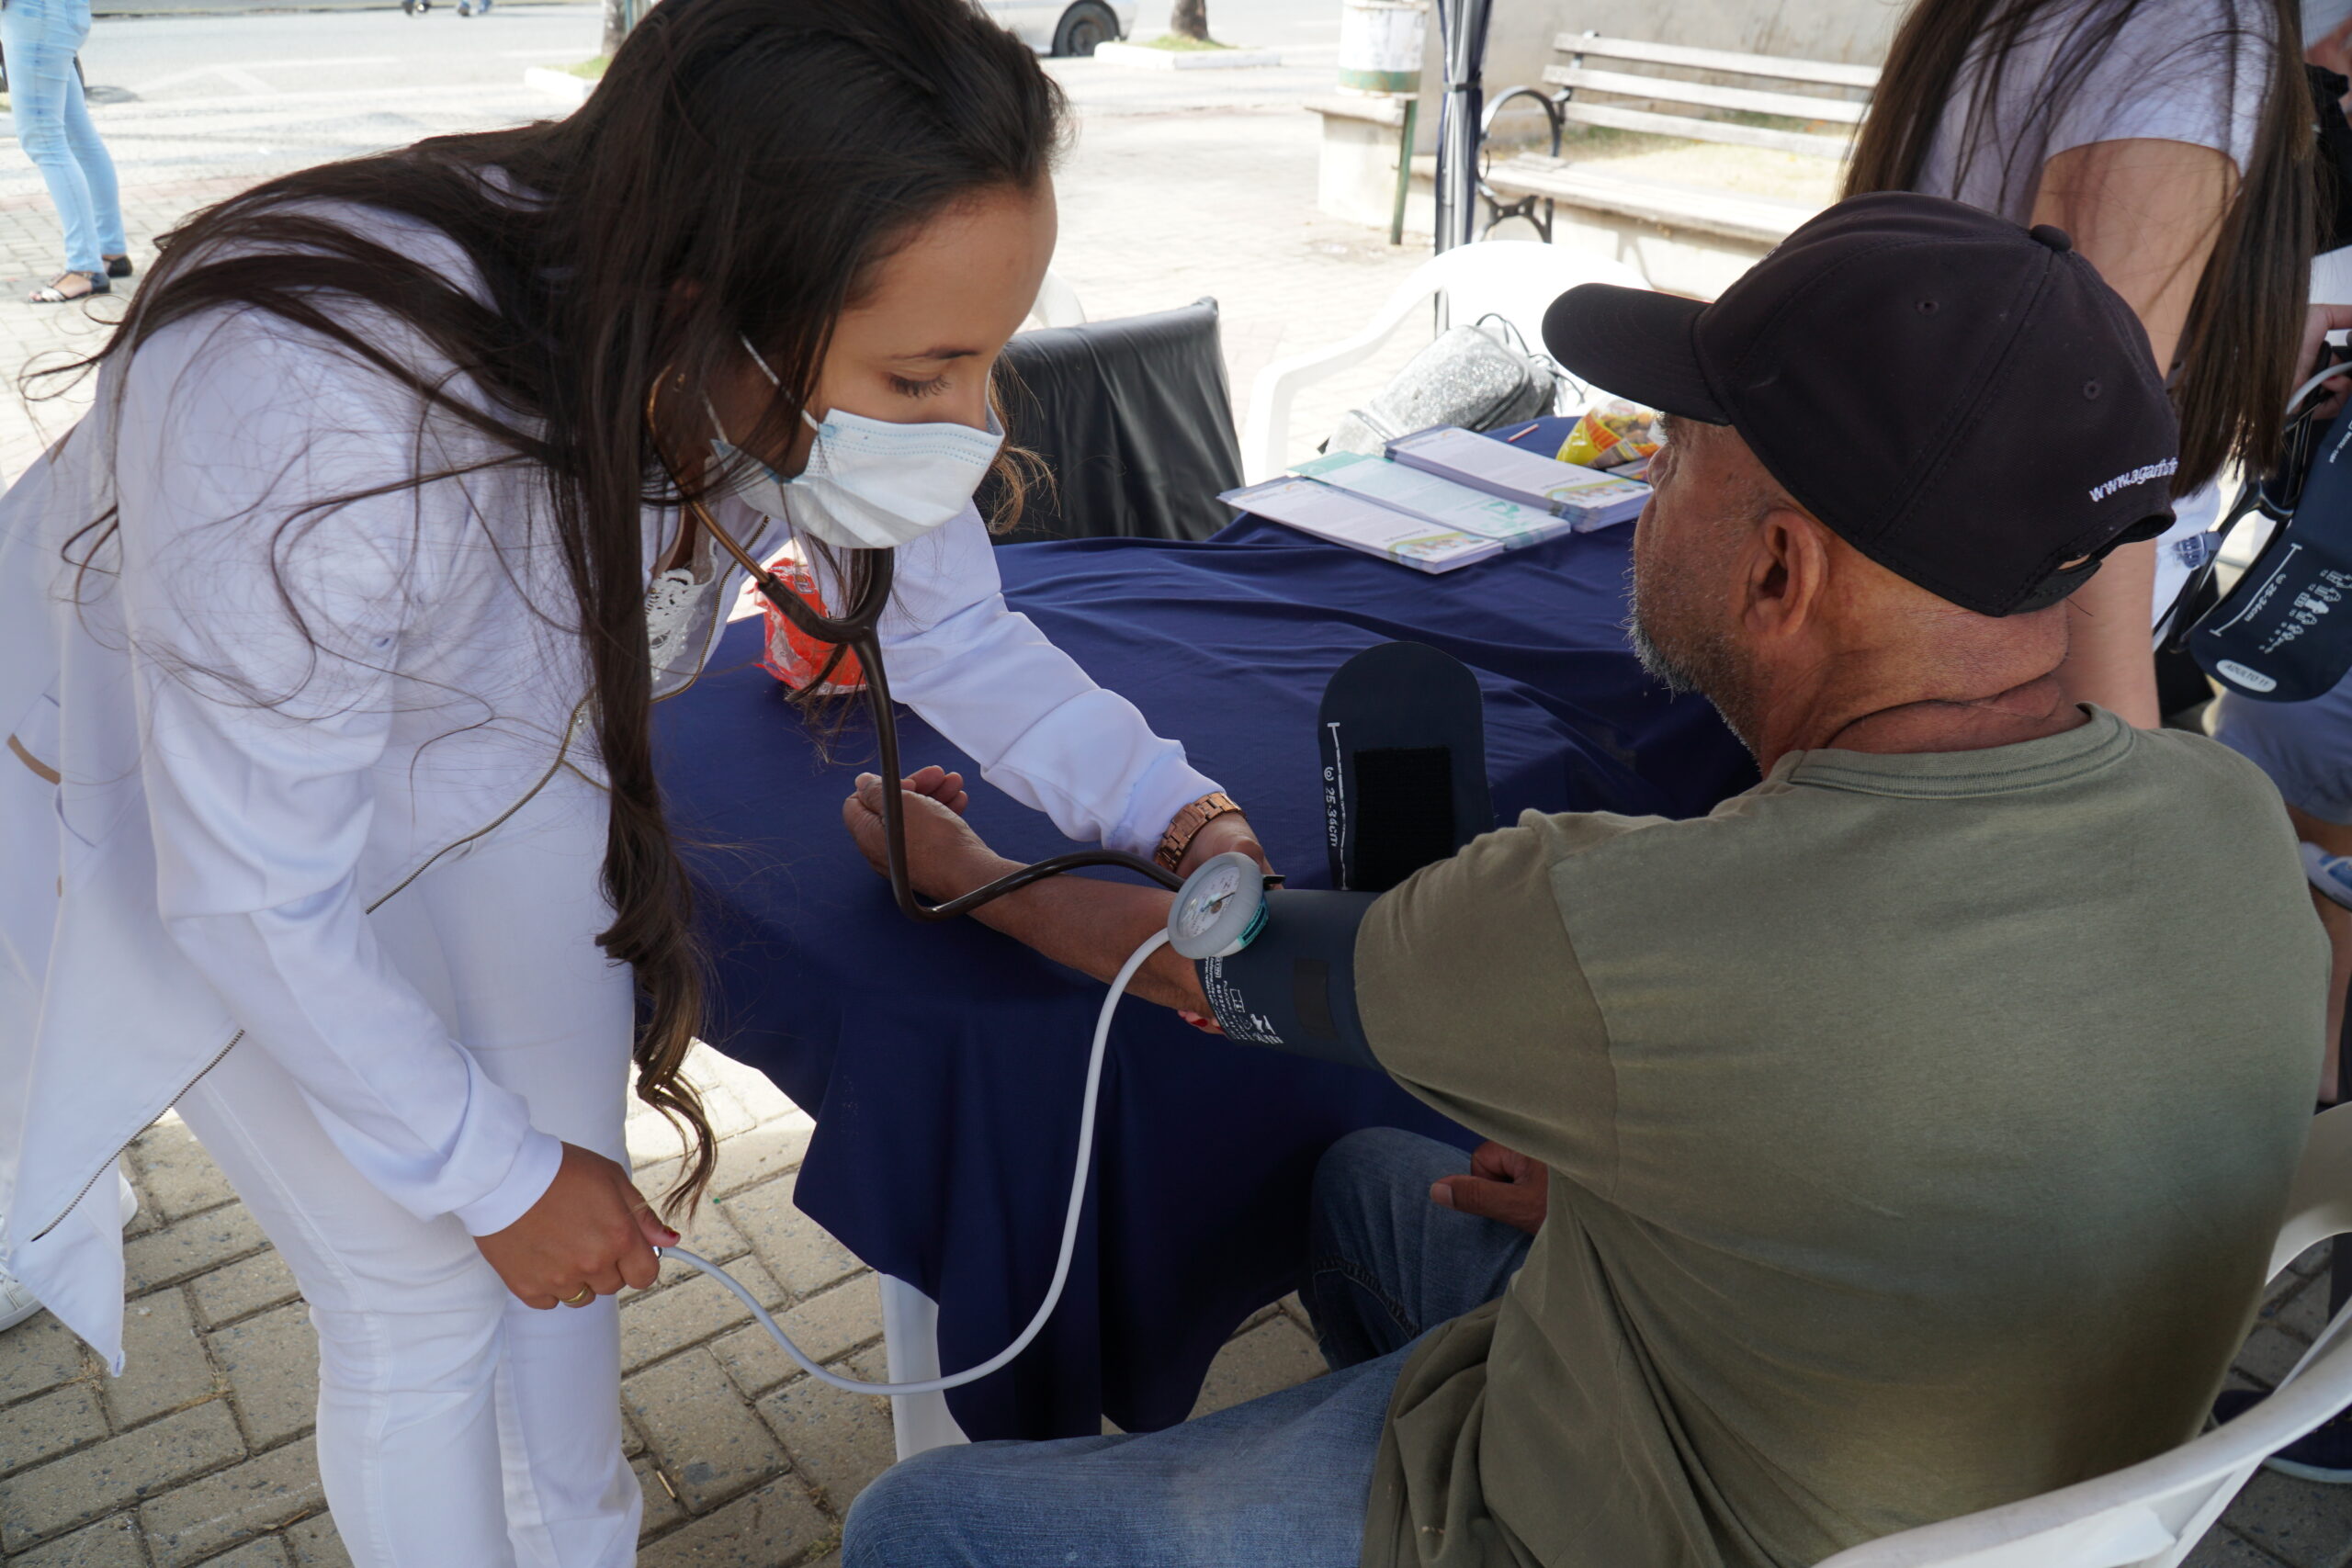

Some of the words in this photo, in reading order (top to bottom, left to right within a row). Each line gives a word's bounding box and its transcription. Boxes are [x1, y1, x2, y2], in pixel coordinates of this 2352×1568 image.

[2244, 583, 2278, 622] 25-34cm
[2225, 663, 2257, 681] ADULTO
[1326, 787, 1339, 847] 25-34cm
